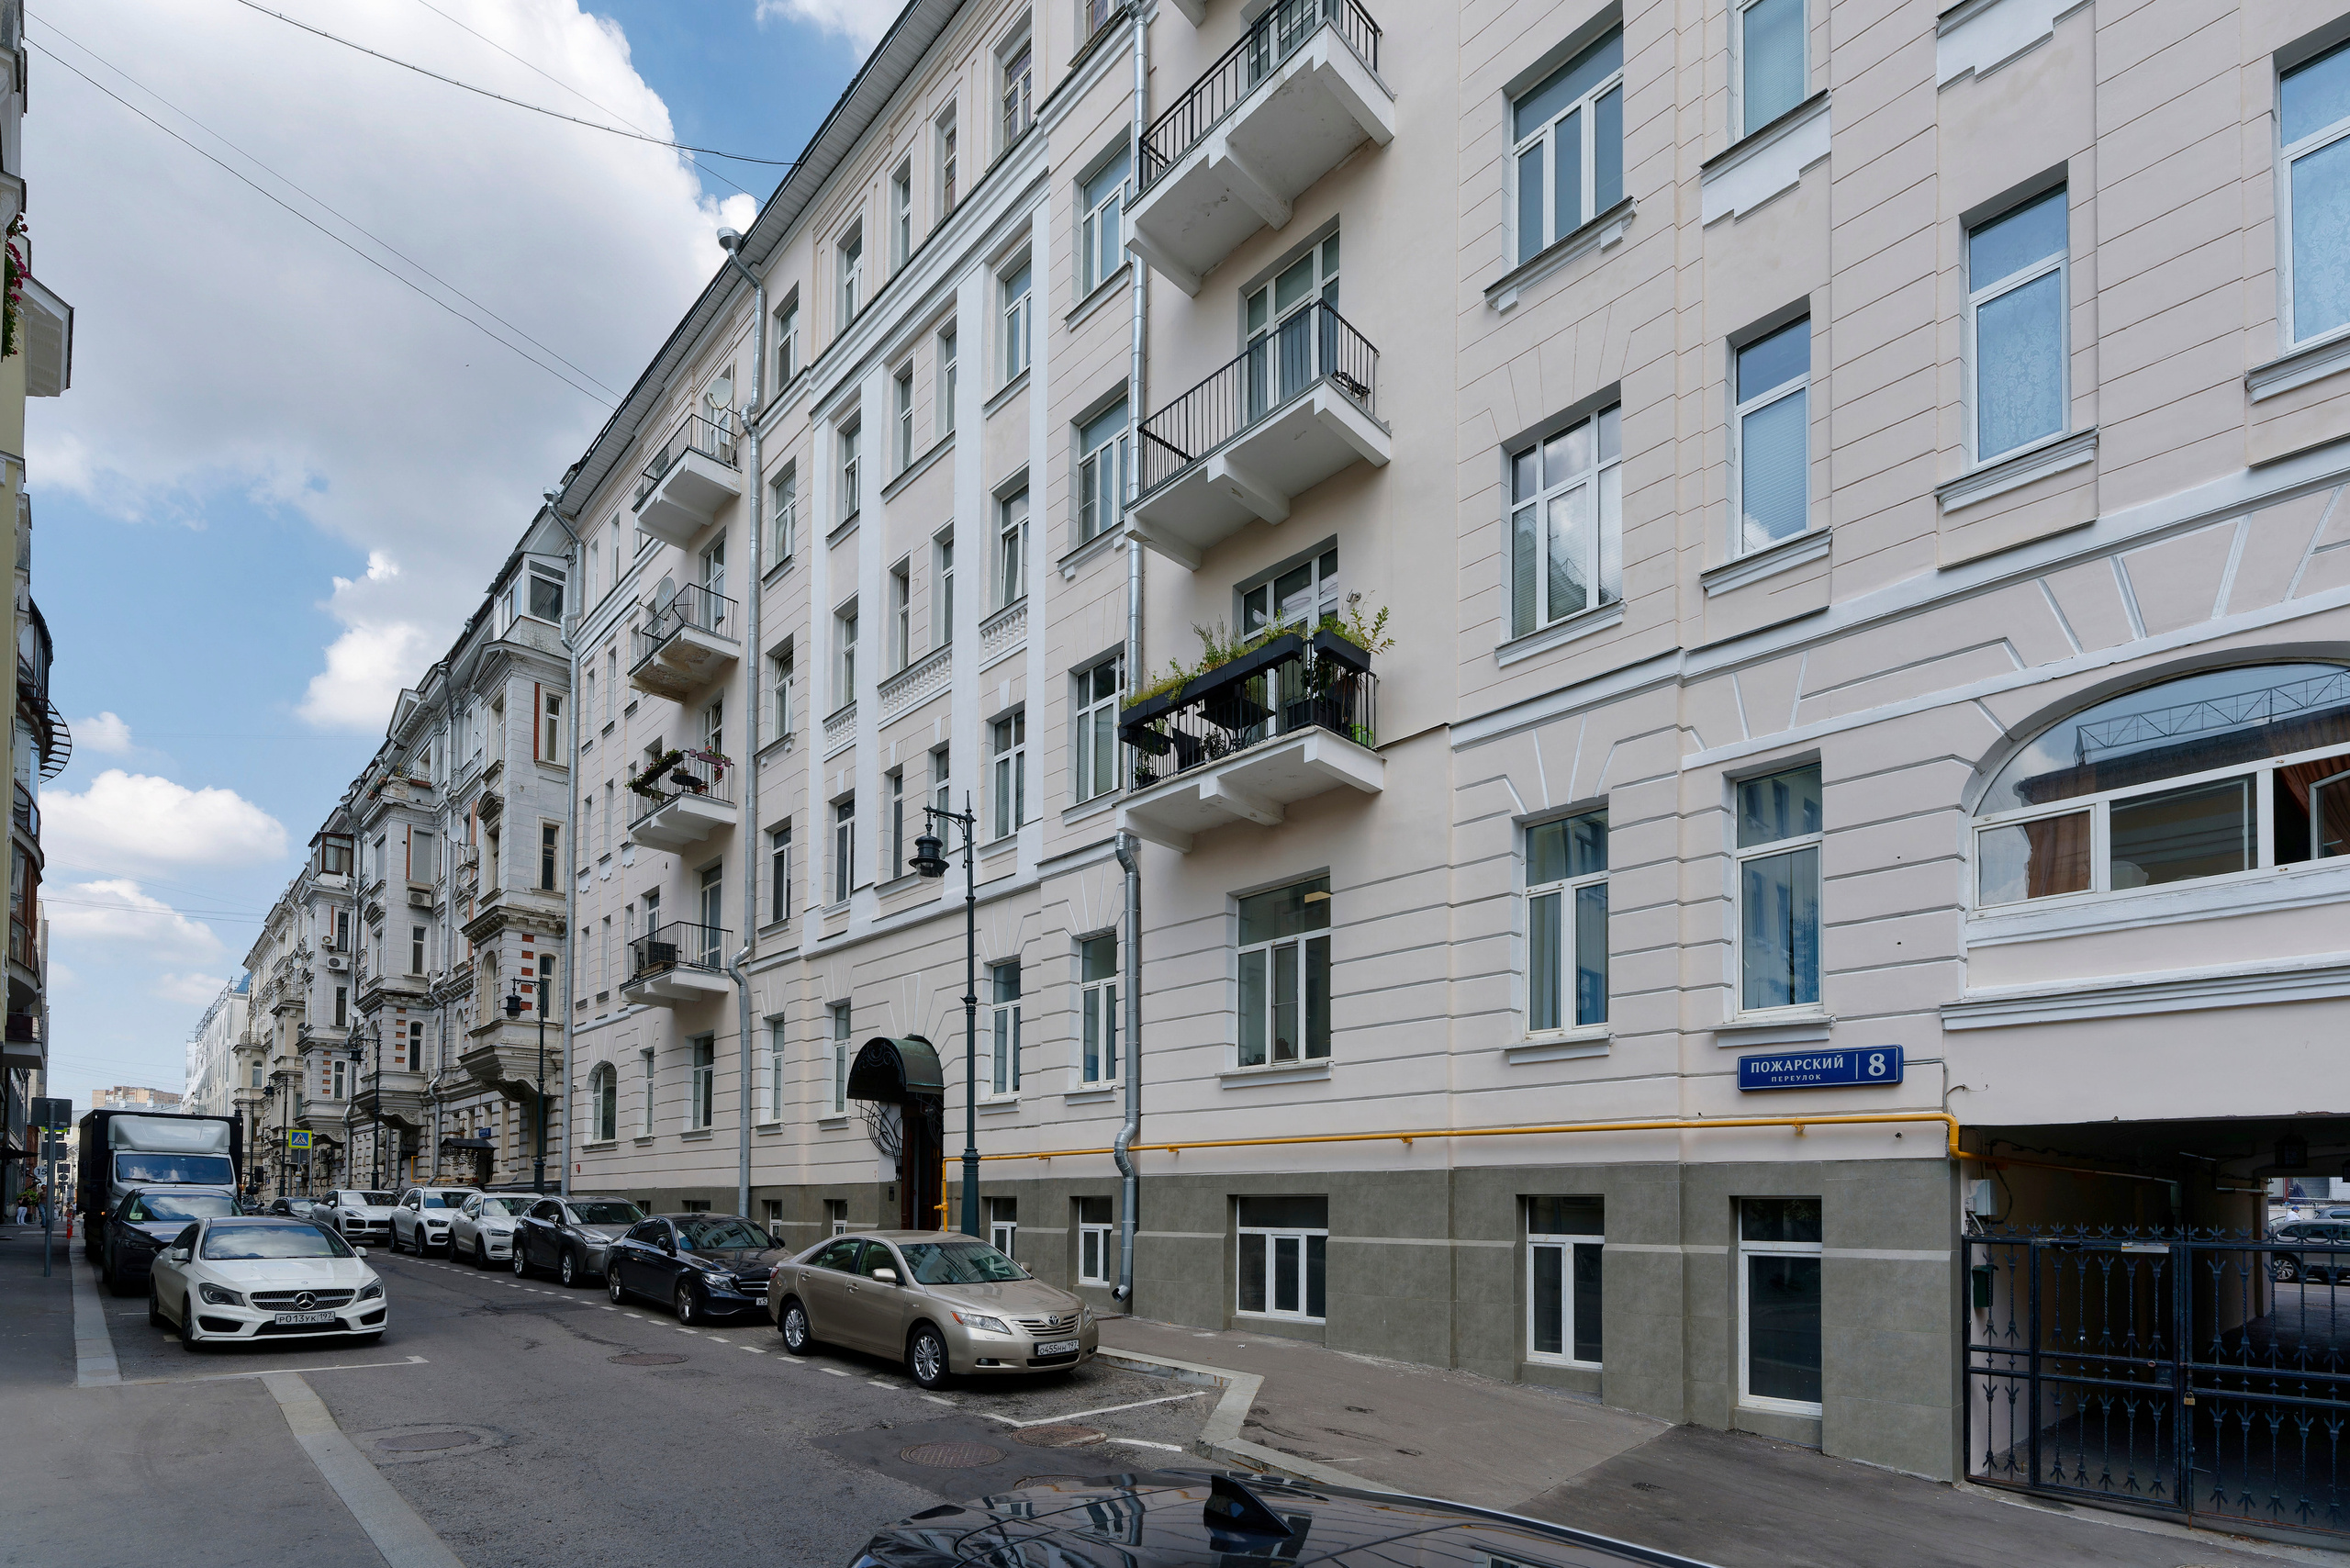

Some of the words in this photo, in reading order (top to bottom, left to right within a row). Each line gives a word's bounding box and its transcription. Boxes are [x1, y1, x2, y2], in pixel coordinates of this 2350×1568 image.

[1751, 1054, 1844, 1073] ПОЖАРСКИЙ
[1867, 1053, 1886, 1077] 8
[1771, 1073, 1821, 1082] ПЕРЕУЛОК
